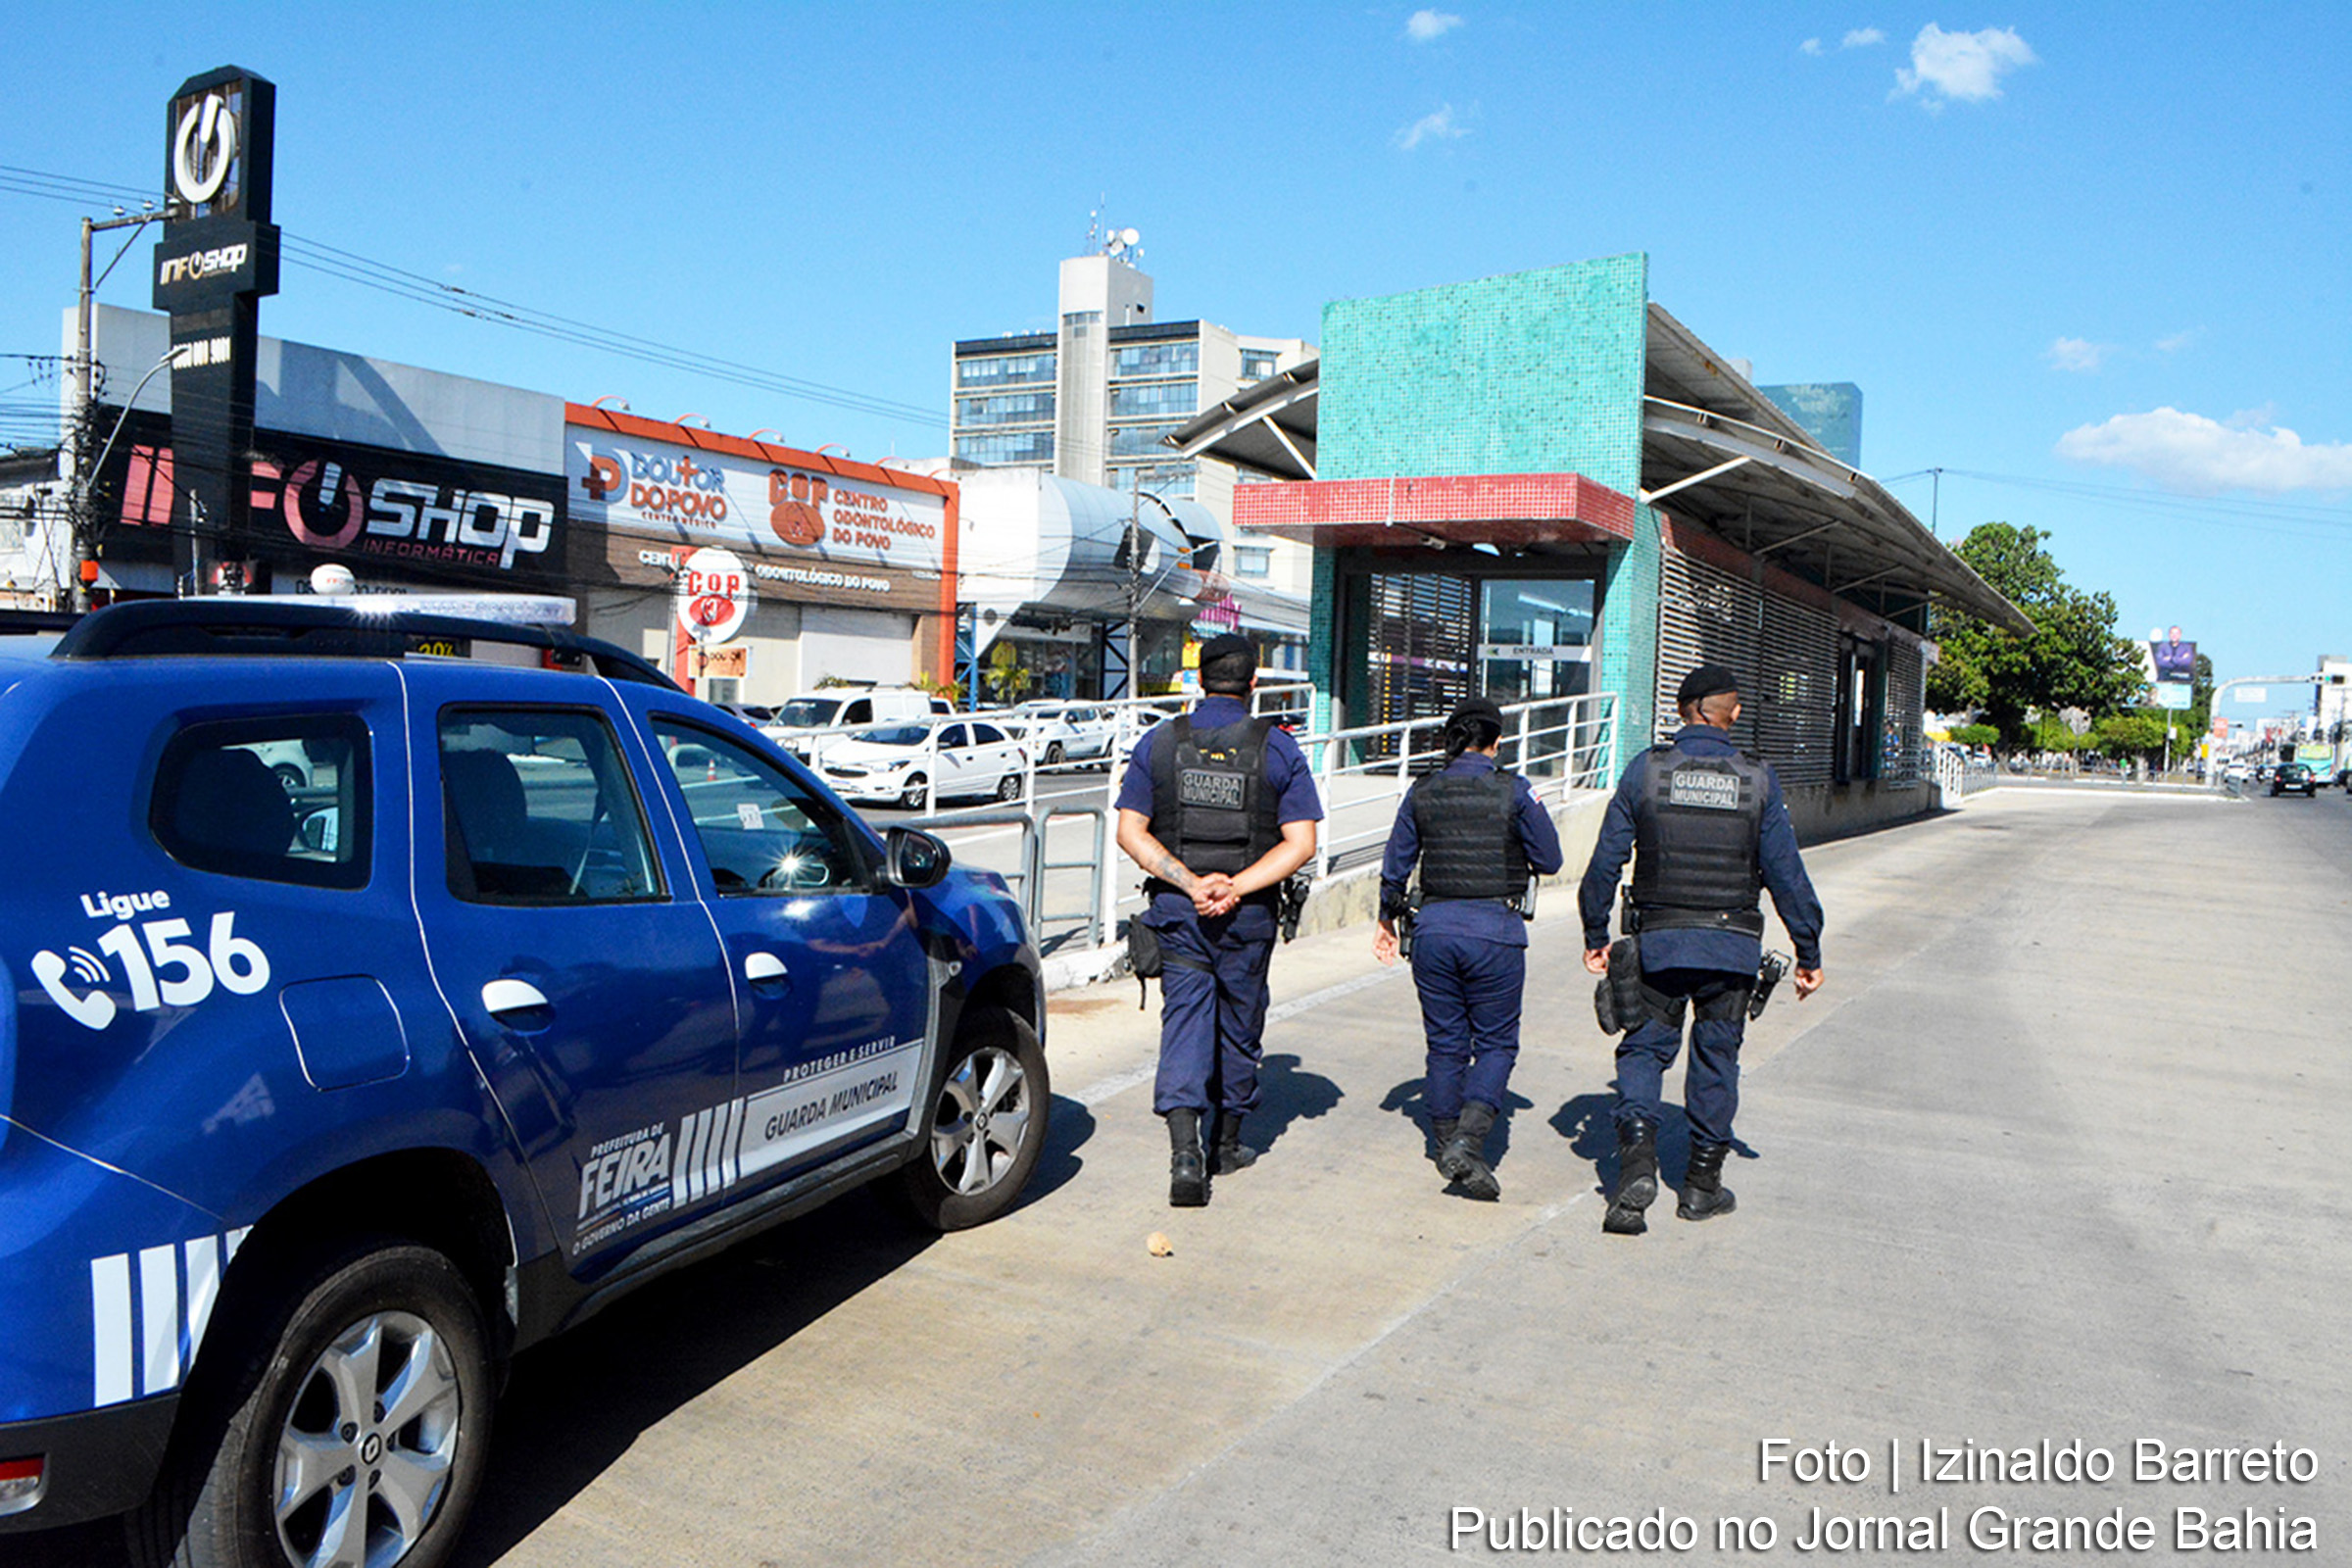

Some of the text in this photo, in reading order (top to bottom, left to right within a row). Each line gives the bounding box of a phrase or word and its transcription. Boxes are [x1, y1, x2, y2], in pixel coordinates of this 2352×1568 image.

[631, 454, 725, 494] DOUTOR
[631, 481, 727, 521] DO POVO
[768, 468, 829, 511] COP
[833, 489, 889, 514] CENTRO
[832, 527, 892, 551] DO POVO
[833, 509, 936, 540] ODONTOLÓGICO
[363, 539, 500, 566] INFORMÁTICA
[688, 570, 741, 600] COP
[755, 564, 844, 587] ODONTOLÓGICO
[844, 575, 861, 589] DO
[860, 576, 892, 593] POVO
[1512, 646, 1555, 657] ENTRADA
[1182, 786, 1240, 806] MUNICIPAL
[1183, 773, 1241, 791] GUARDA
[1676, 774, 1736, 792] GUARDA
[1674, 789, 1735, 807] MUNICIPAL
[80, 890, 171, 920] Ligue
[97, 911, 270, 1011] 156
[784, 1035, 897, 1083] PROTEGER E SERVIR
[764, 1070, 899, 1142] GUARDA MUNICIPAL
[590, 1121, 665, 1159] PREFEITURA DE
[578, 1132, 671, 1221] FEIRA
[571, 1241, 581, 1256] O
[581, 1217, 626, 1250] GOVERNO
[626, 1209, 641, 1227] DA
[642, 1197, 671, 1220] GENTE
